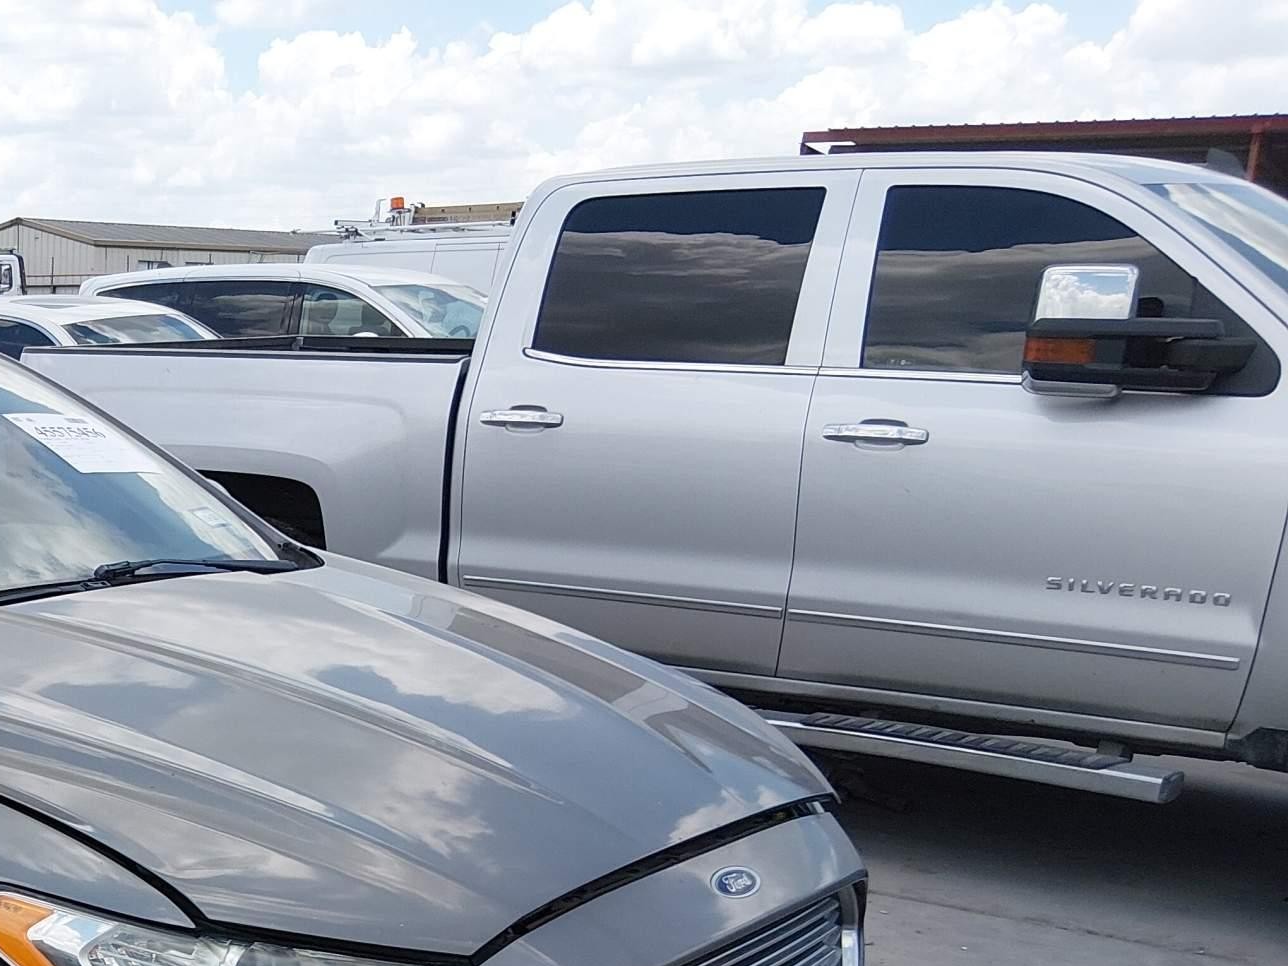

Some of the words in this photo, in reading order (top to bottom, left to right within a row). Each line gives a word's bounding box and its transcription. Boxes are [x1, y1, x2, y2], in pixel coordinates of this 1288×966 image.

[34, 426, 106, 439] 45575456
[1045, 575, 1232, 607] SILVERADO
[721, 872, 753, 893] Ford
